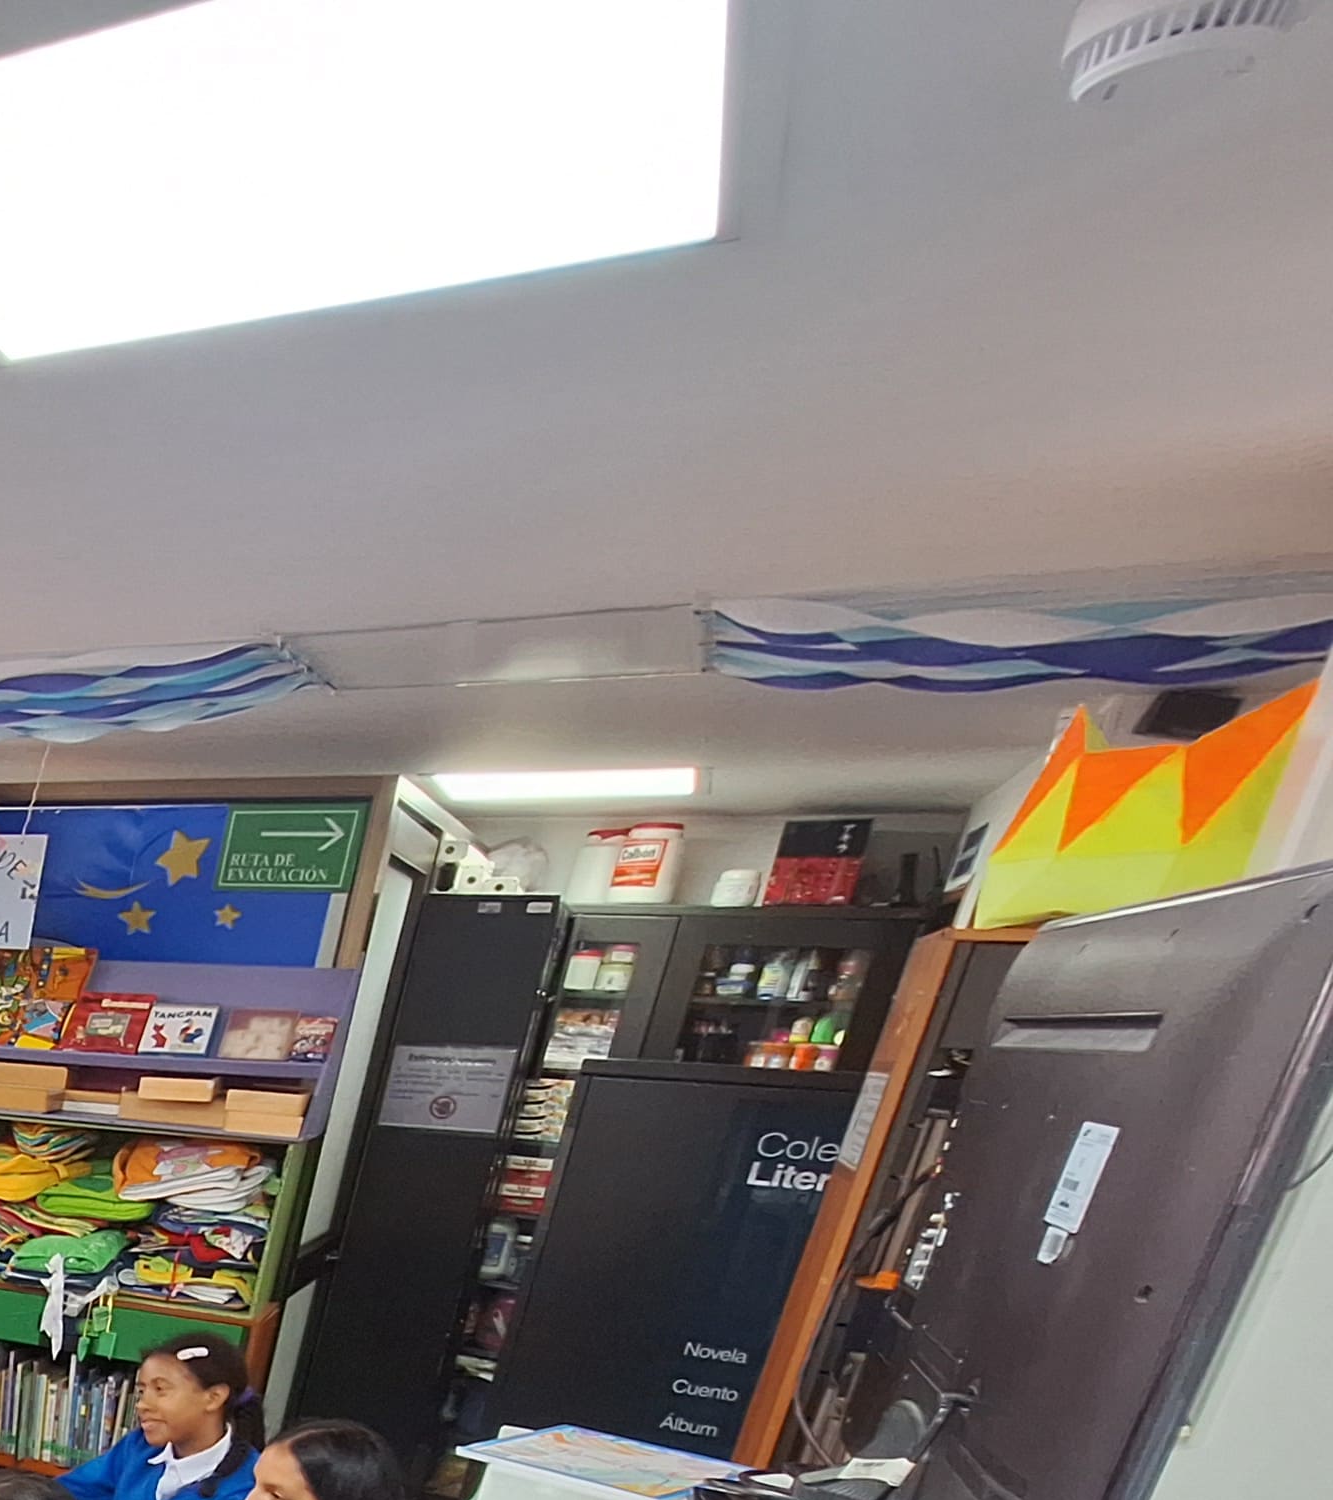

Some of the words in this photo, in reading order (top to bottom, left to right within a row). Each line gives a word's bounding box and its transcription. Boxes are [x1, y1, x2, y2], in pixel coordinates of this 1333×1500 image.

[230, 853, 270, 867] RUTA
[274, 853, 297, 867] DE
[226, 865, 329, 882] EVACUACIÓN
[757, 1132, 840, 1163] Cole
[746, 1161, 832, 1193] Liter
[683, 1341, 748, 1364] Novela
[671, 1378, 739, 1402] Cuento
[659, 1412, 719, 1437] Álbum
